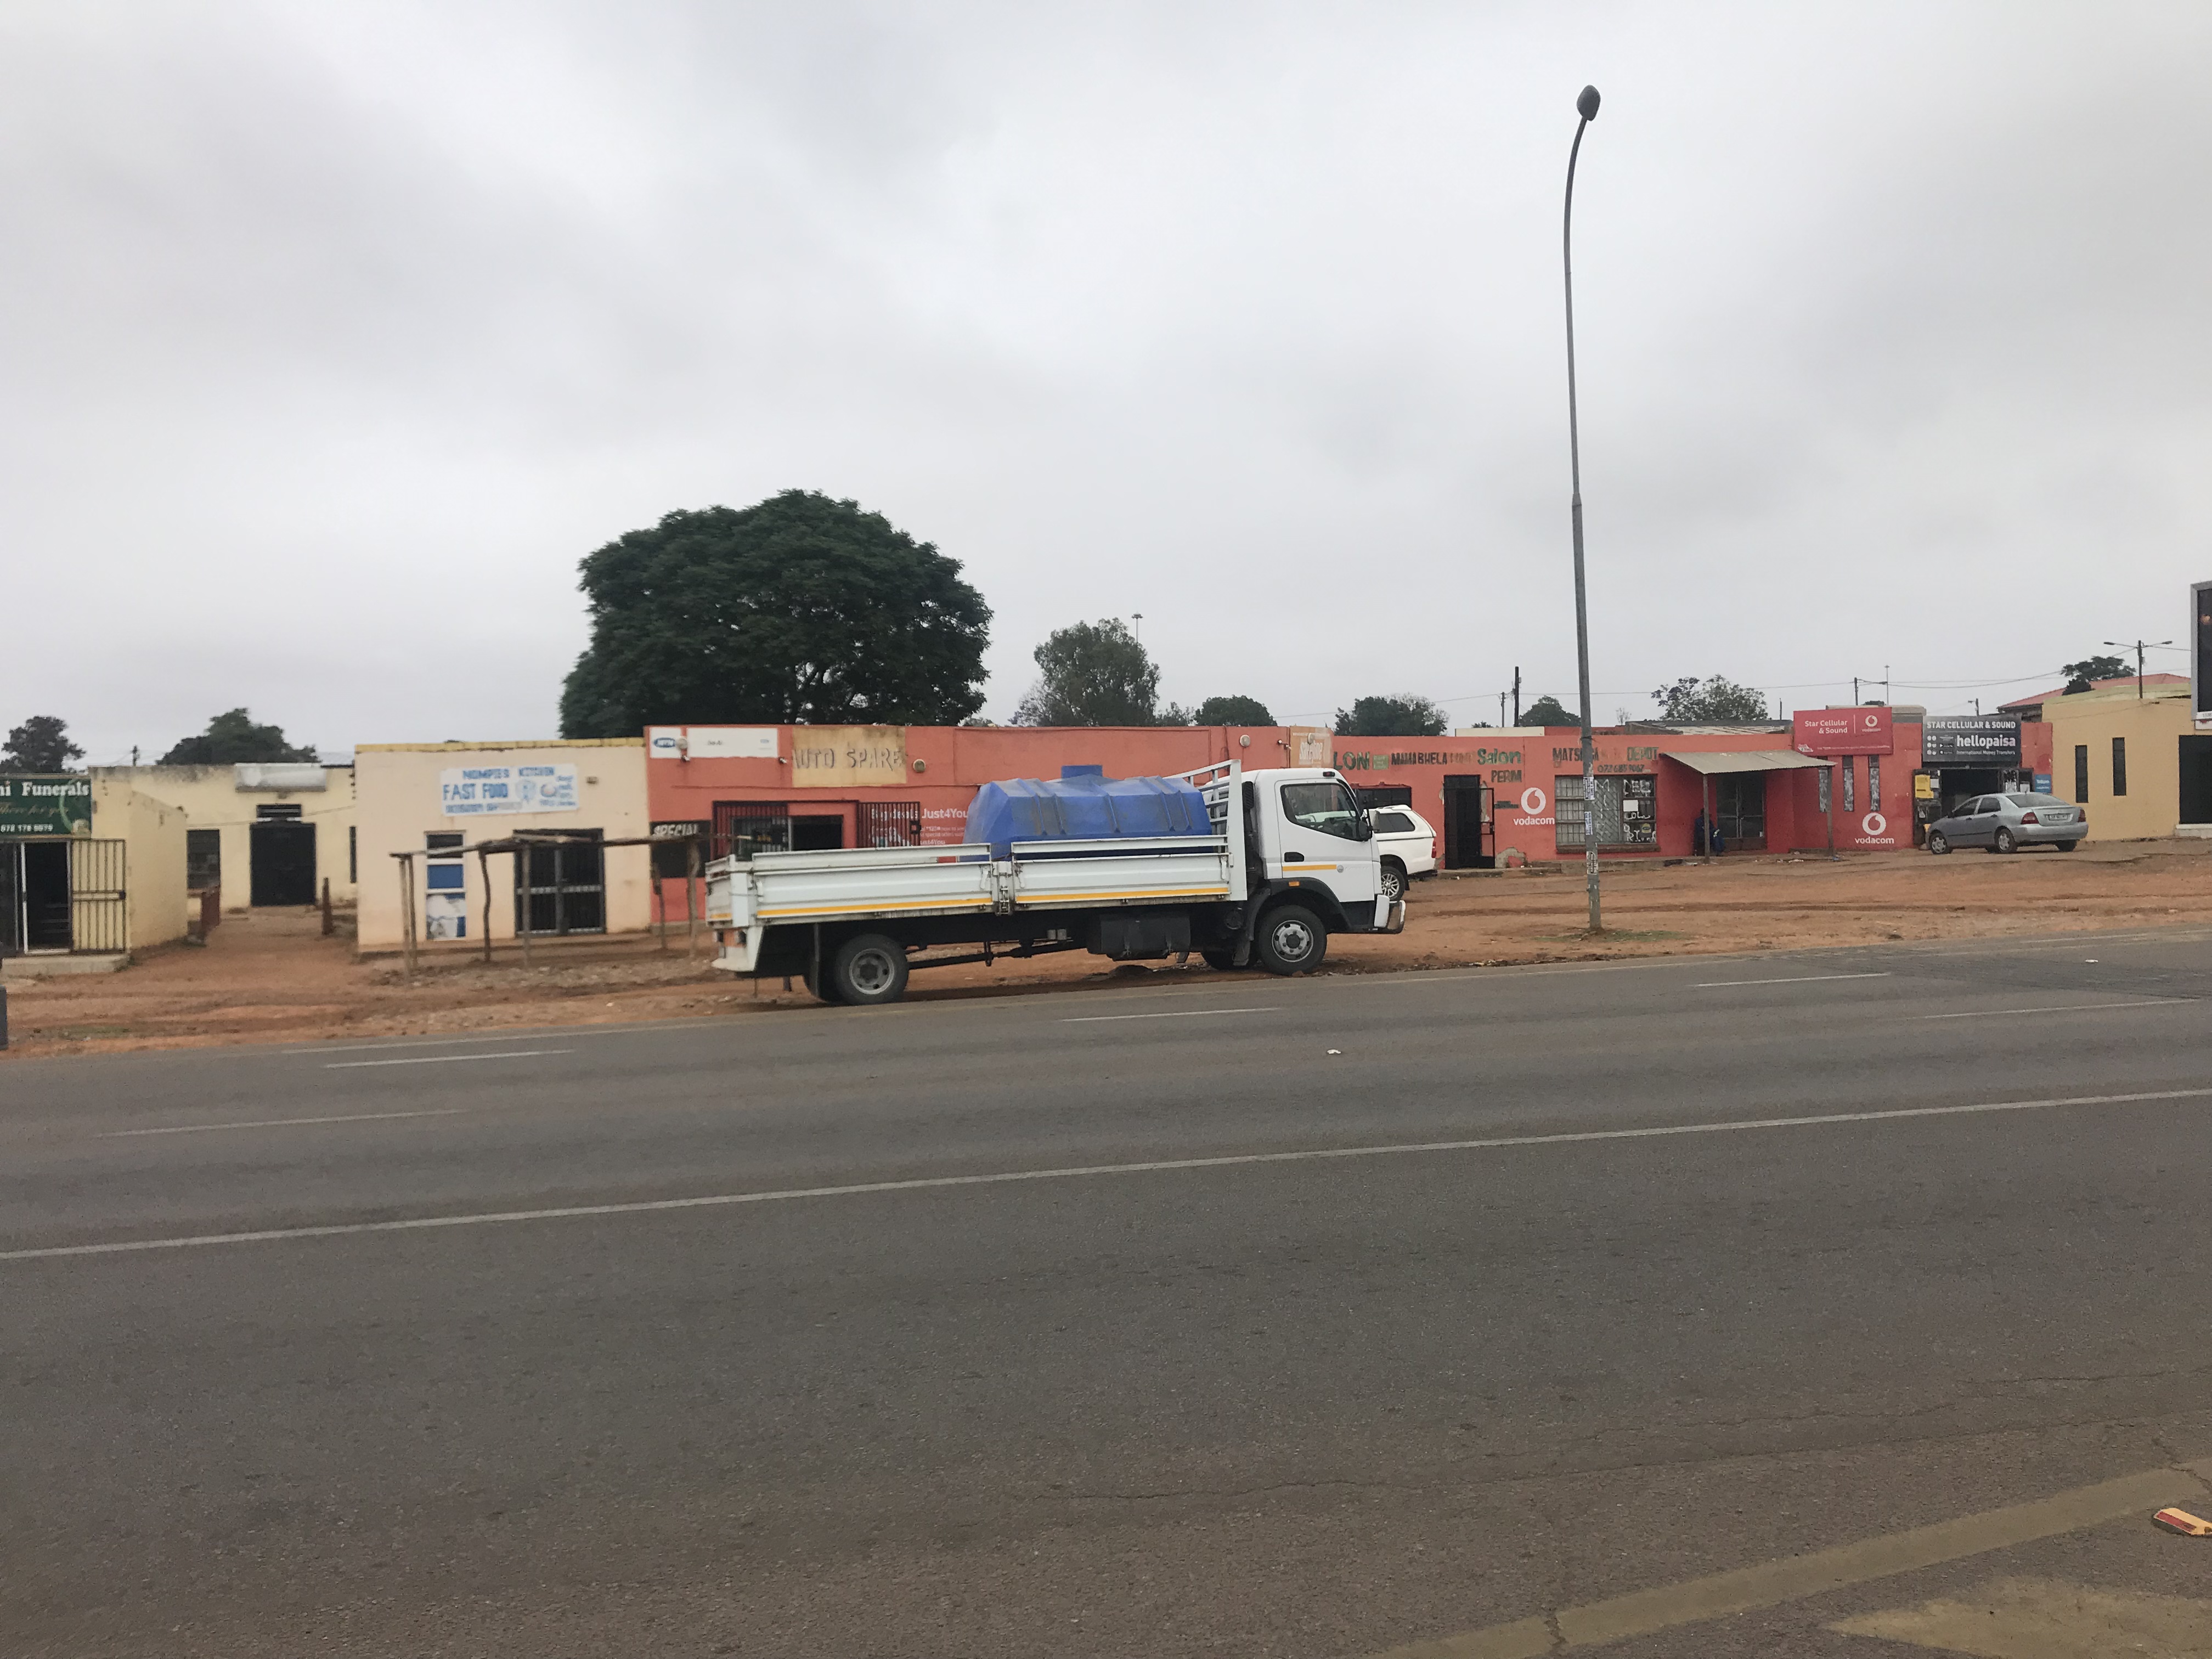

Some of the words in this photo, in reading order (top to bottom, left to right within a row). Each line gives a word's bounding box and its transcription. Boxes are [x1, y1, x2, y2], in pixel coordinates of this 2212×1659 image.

[1956, 734, 2016, 749] hellopaisa
[1477, 748, 1522, 765] Salon
[1627, 747, 1659, 761] DEPOT
[1491, 769, 1522, 783] PERM
[21, 781, 89, 796] Funerals
[442, 783, 476, 800] FAST
[482, 782, 509, 798] FOOD
[1513, 816, 1555, 826] vodacom
